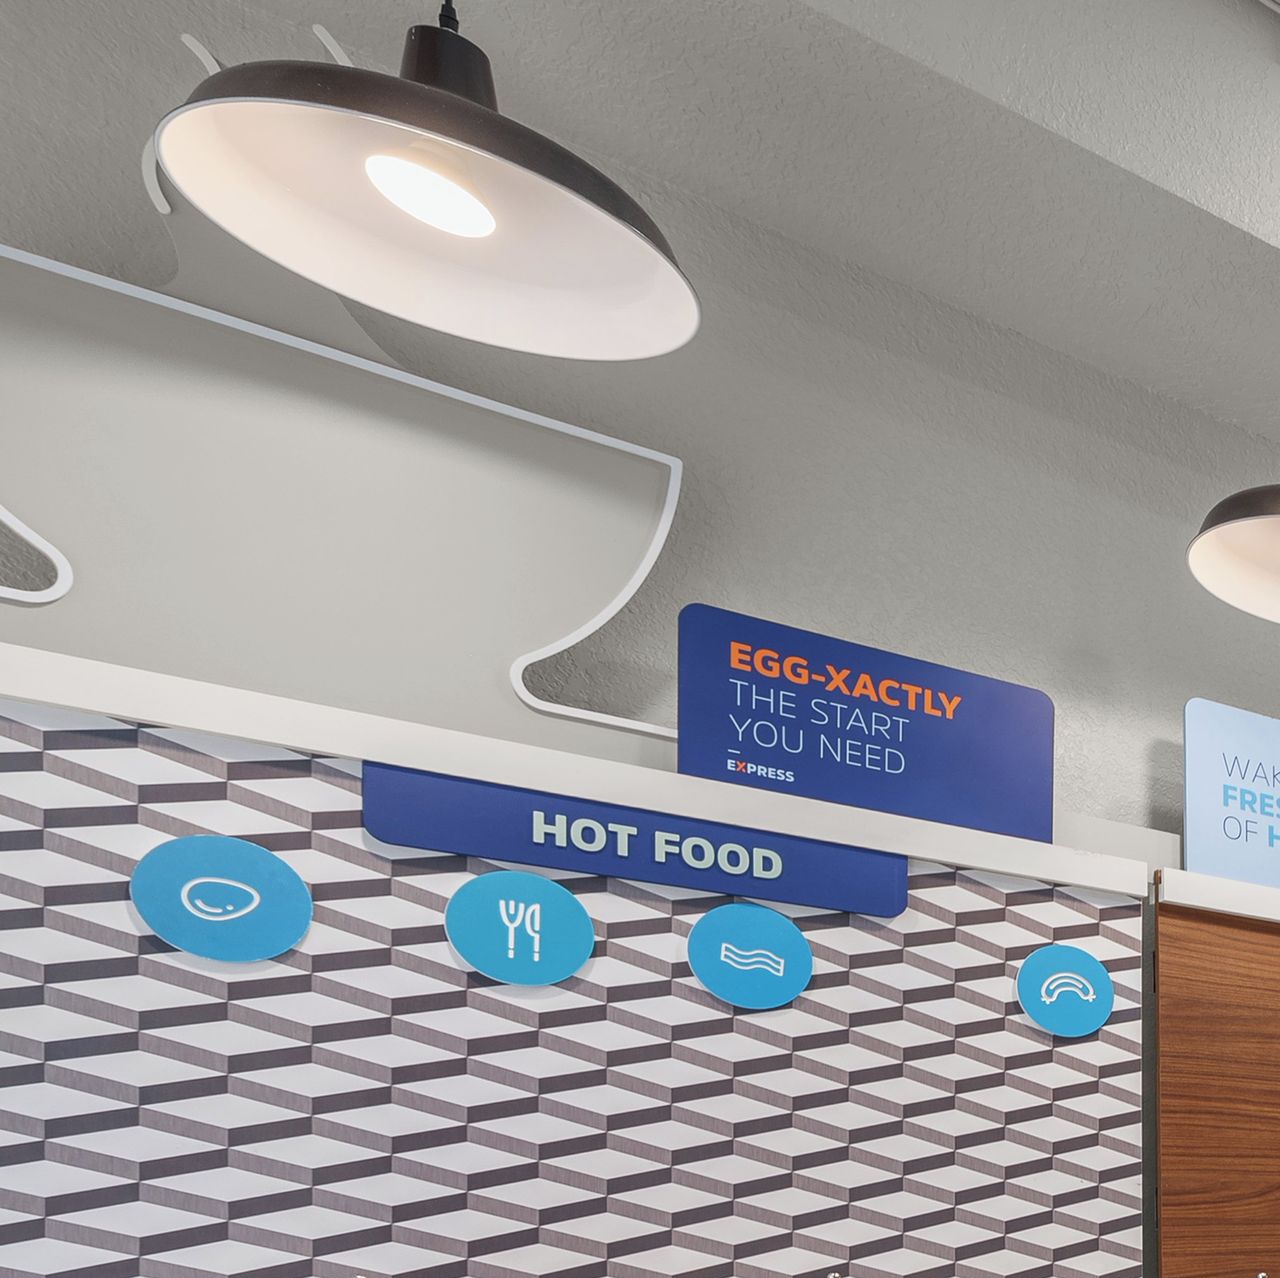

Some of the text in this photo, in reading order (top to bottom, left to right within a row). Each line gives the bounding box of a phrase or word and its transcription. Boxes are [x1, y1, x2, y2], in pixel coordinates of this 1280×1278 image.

[729, 640, 962, 720] EGG-XACTLY
[729, 679, 909, 742] THE START
[727, 759, 794, 782] EXPRESS
[728, 714, 905, 773] YOU NEED
[533, 811, 783, 880] HOT FOOD
[1222, 816, 1257, 842] OF
